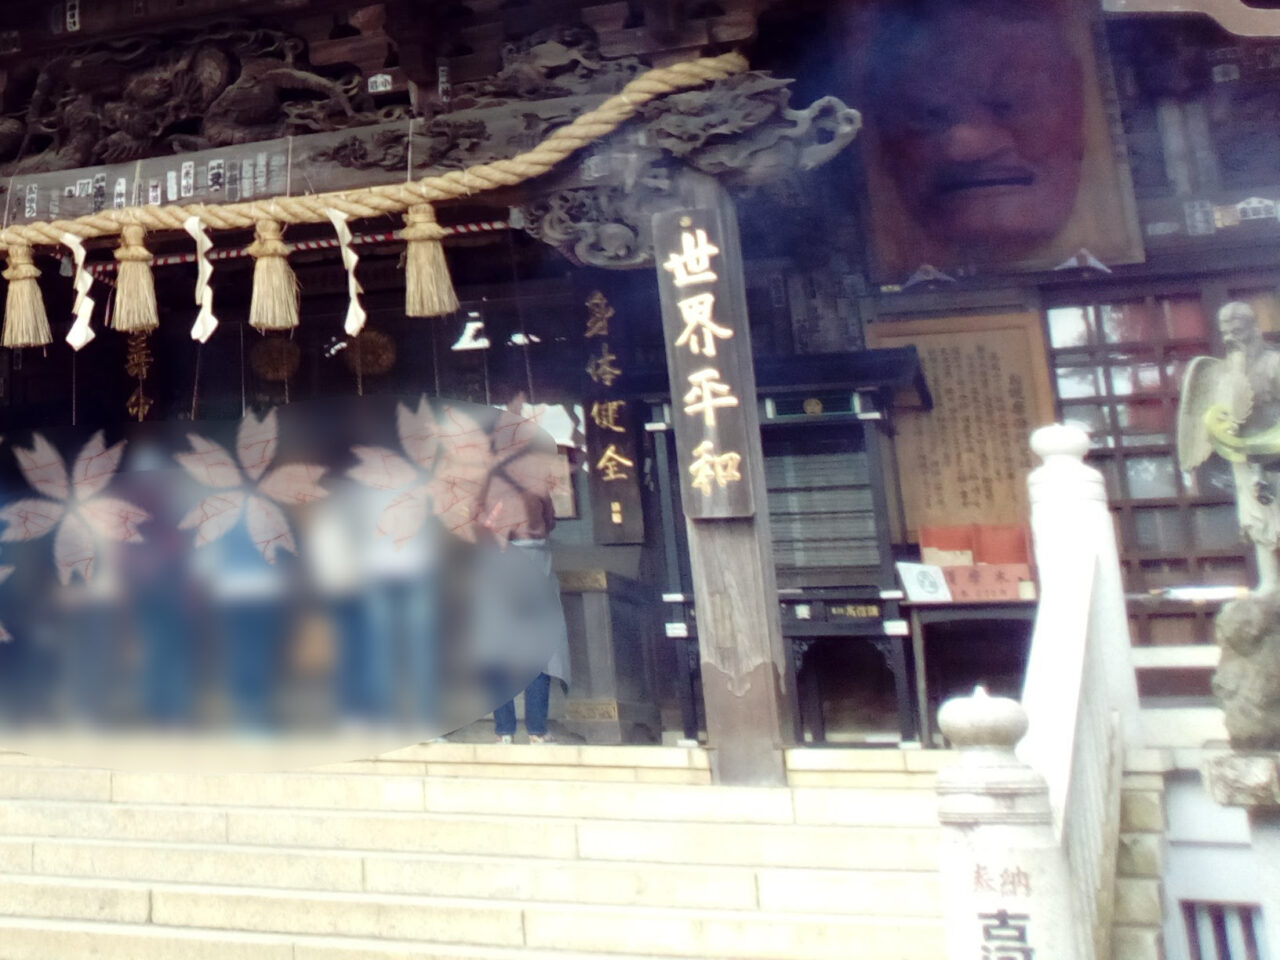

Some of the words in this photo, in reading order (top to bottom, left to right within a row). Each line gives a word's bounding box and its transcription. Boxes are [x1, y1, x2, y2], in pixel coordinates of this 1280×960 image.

[584, 291, 633, 481] 身体健全
[663, 229, 741, 496] 世界平和
[974, 863, 1032, 897] 奉納
